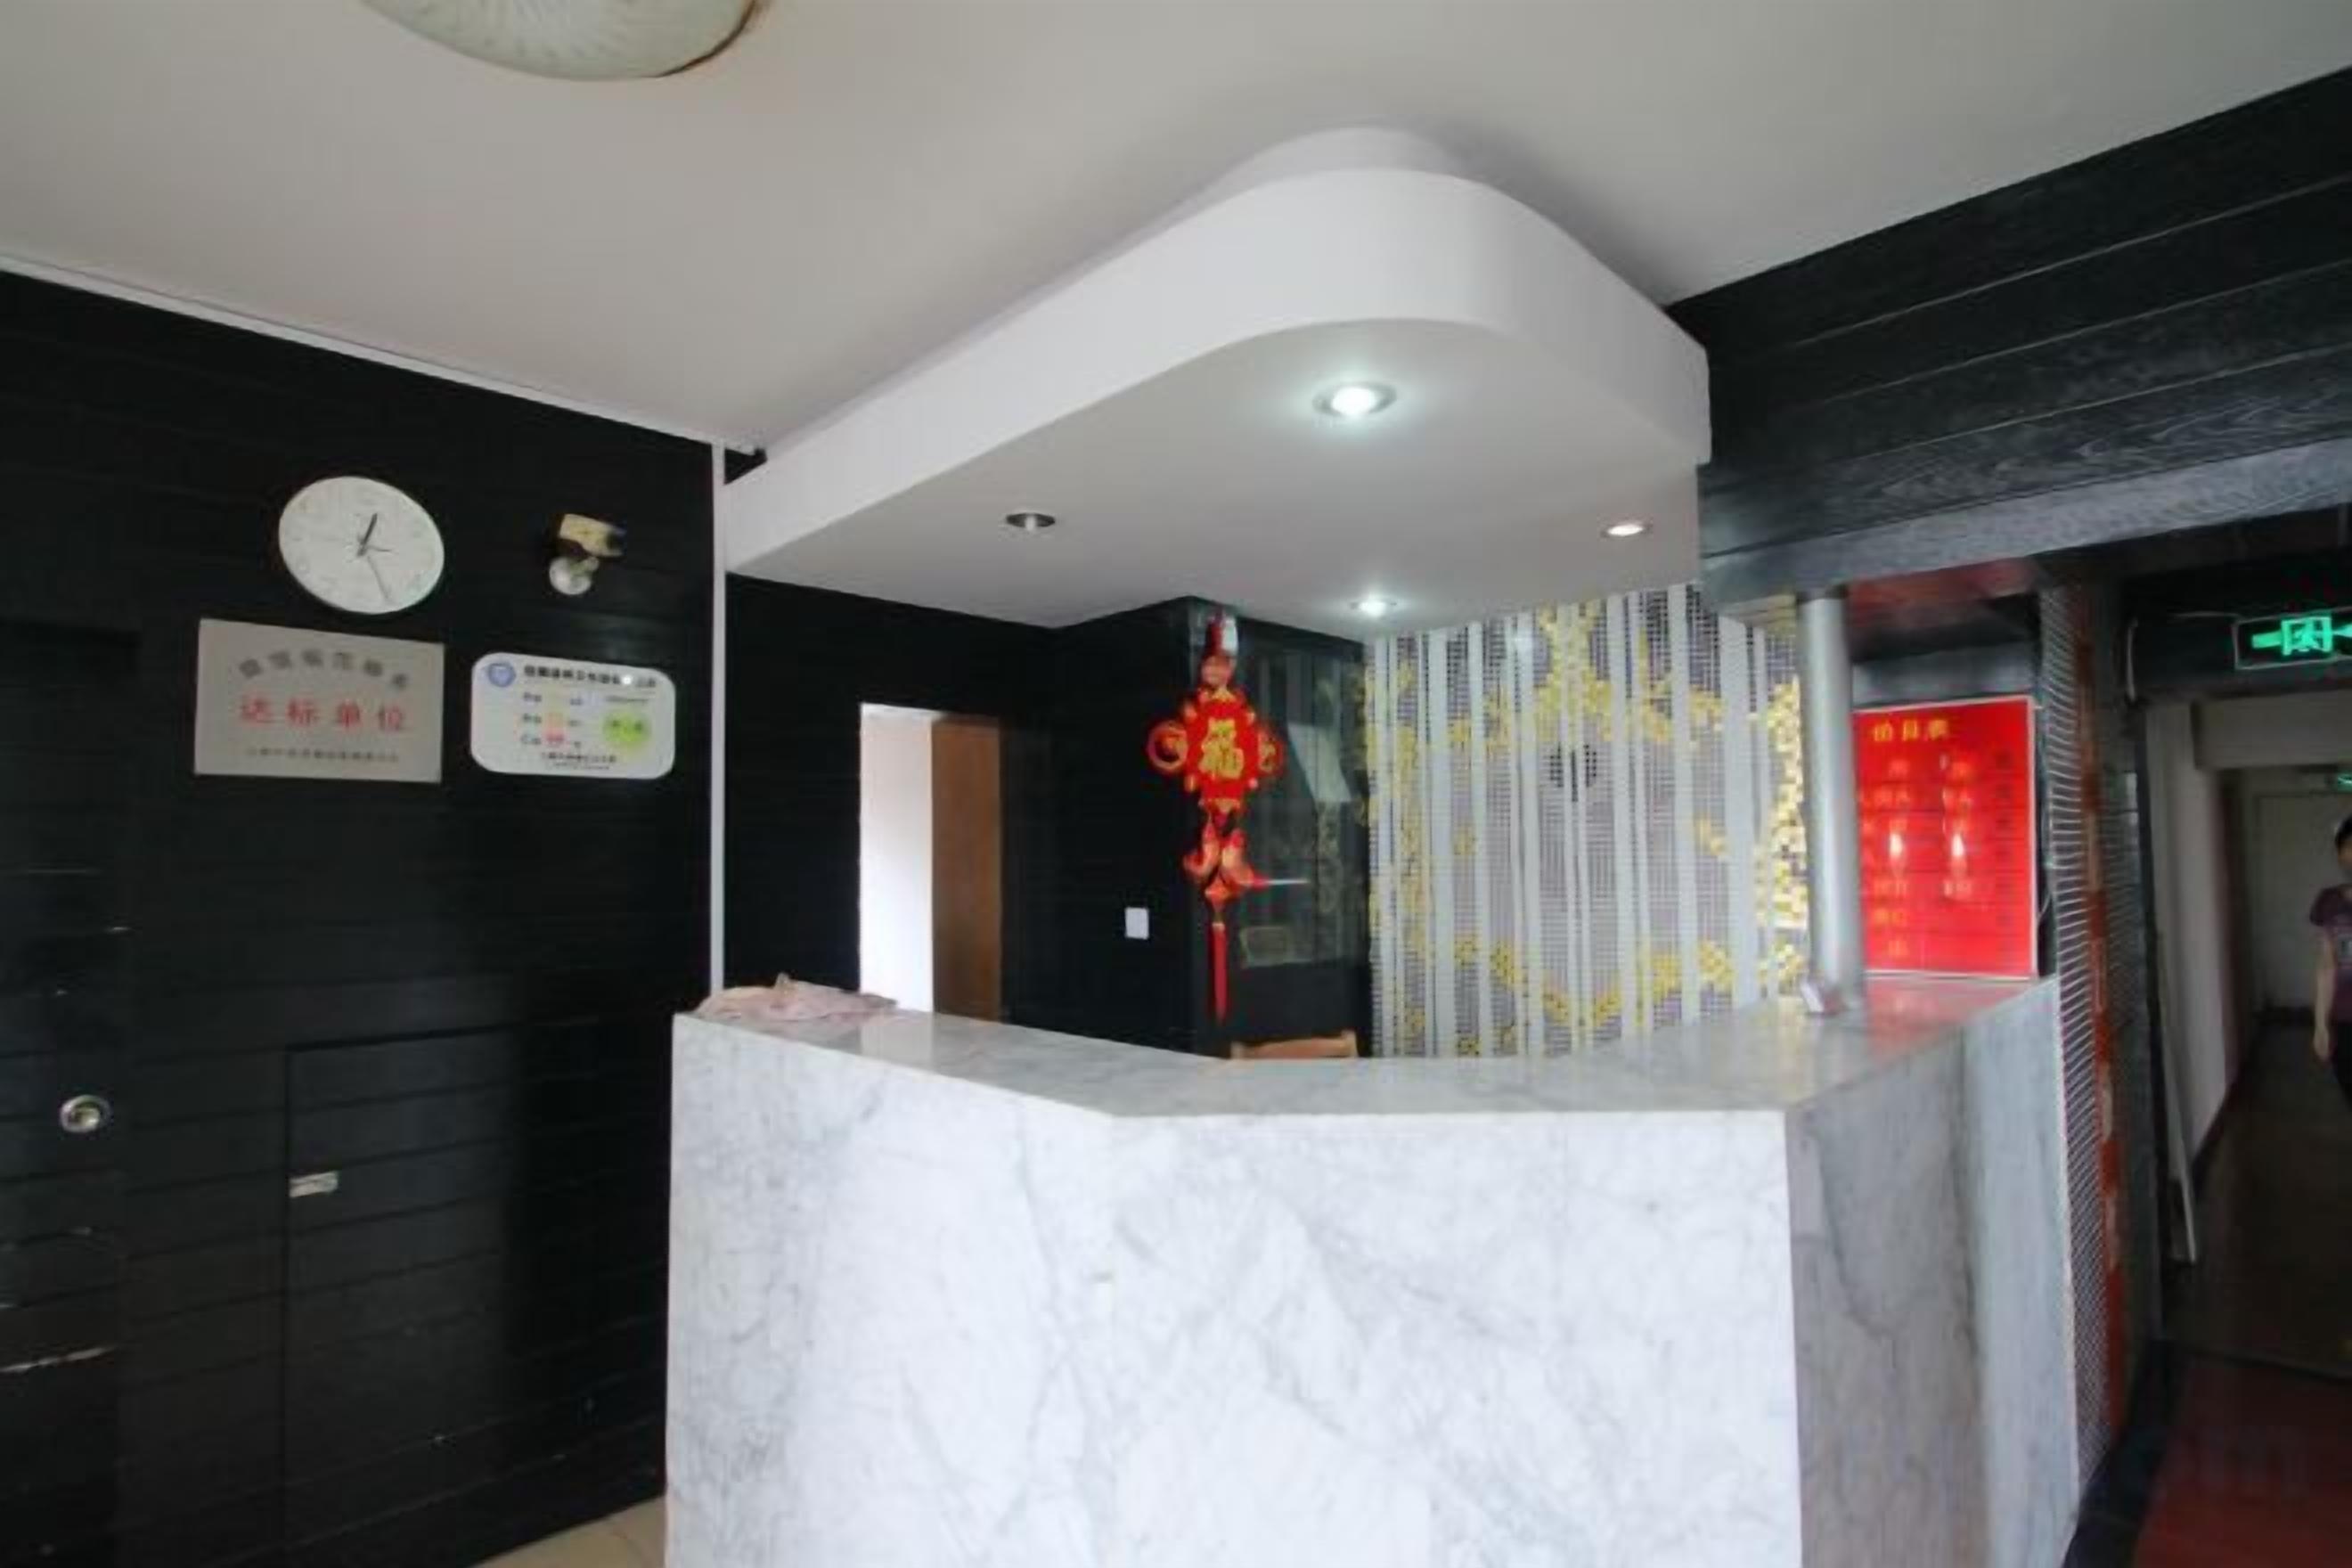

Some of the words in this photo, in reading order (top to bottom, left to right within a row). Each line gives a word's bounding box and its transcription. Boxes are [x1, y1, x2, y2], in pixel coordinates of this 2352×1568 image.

[239, 697, 407, 731] 达标单位
[1199, 718, 1245, 780] 福
